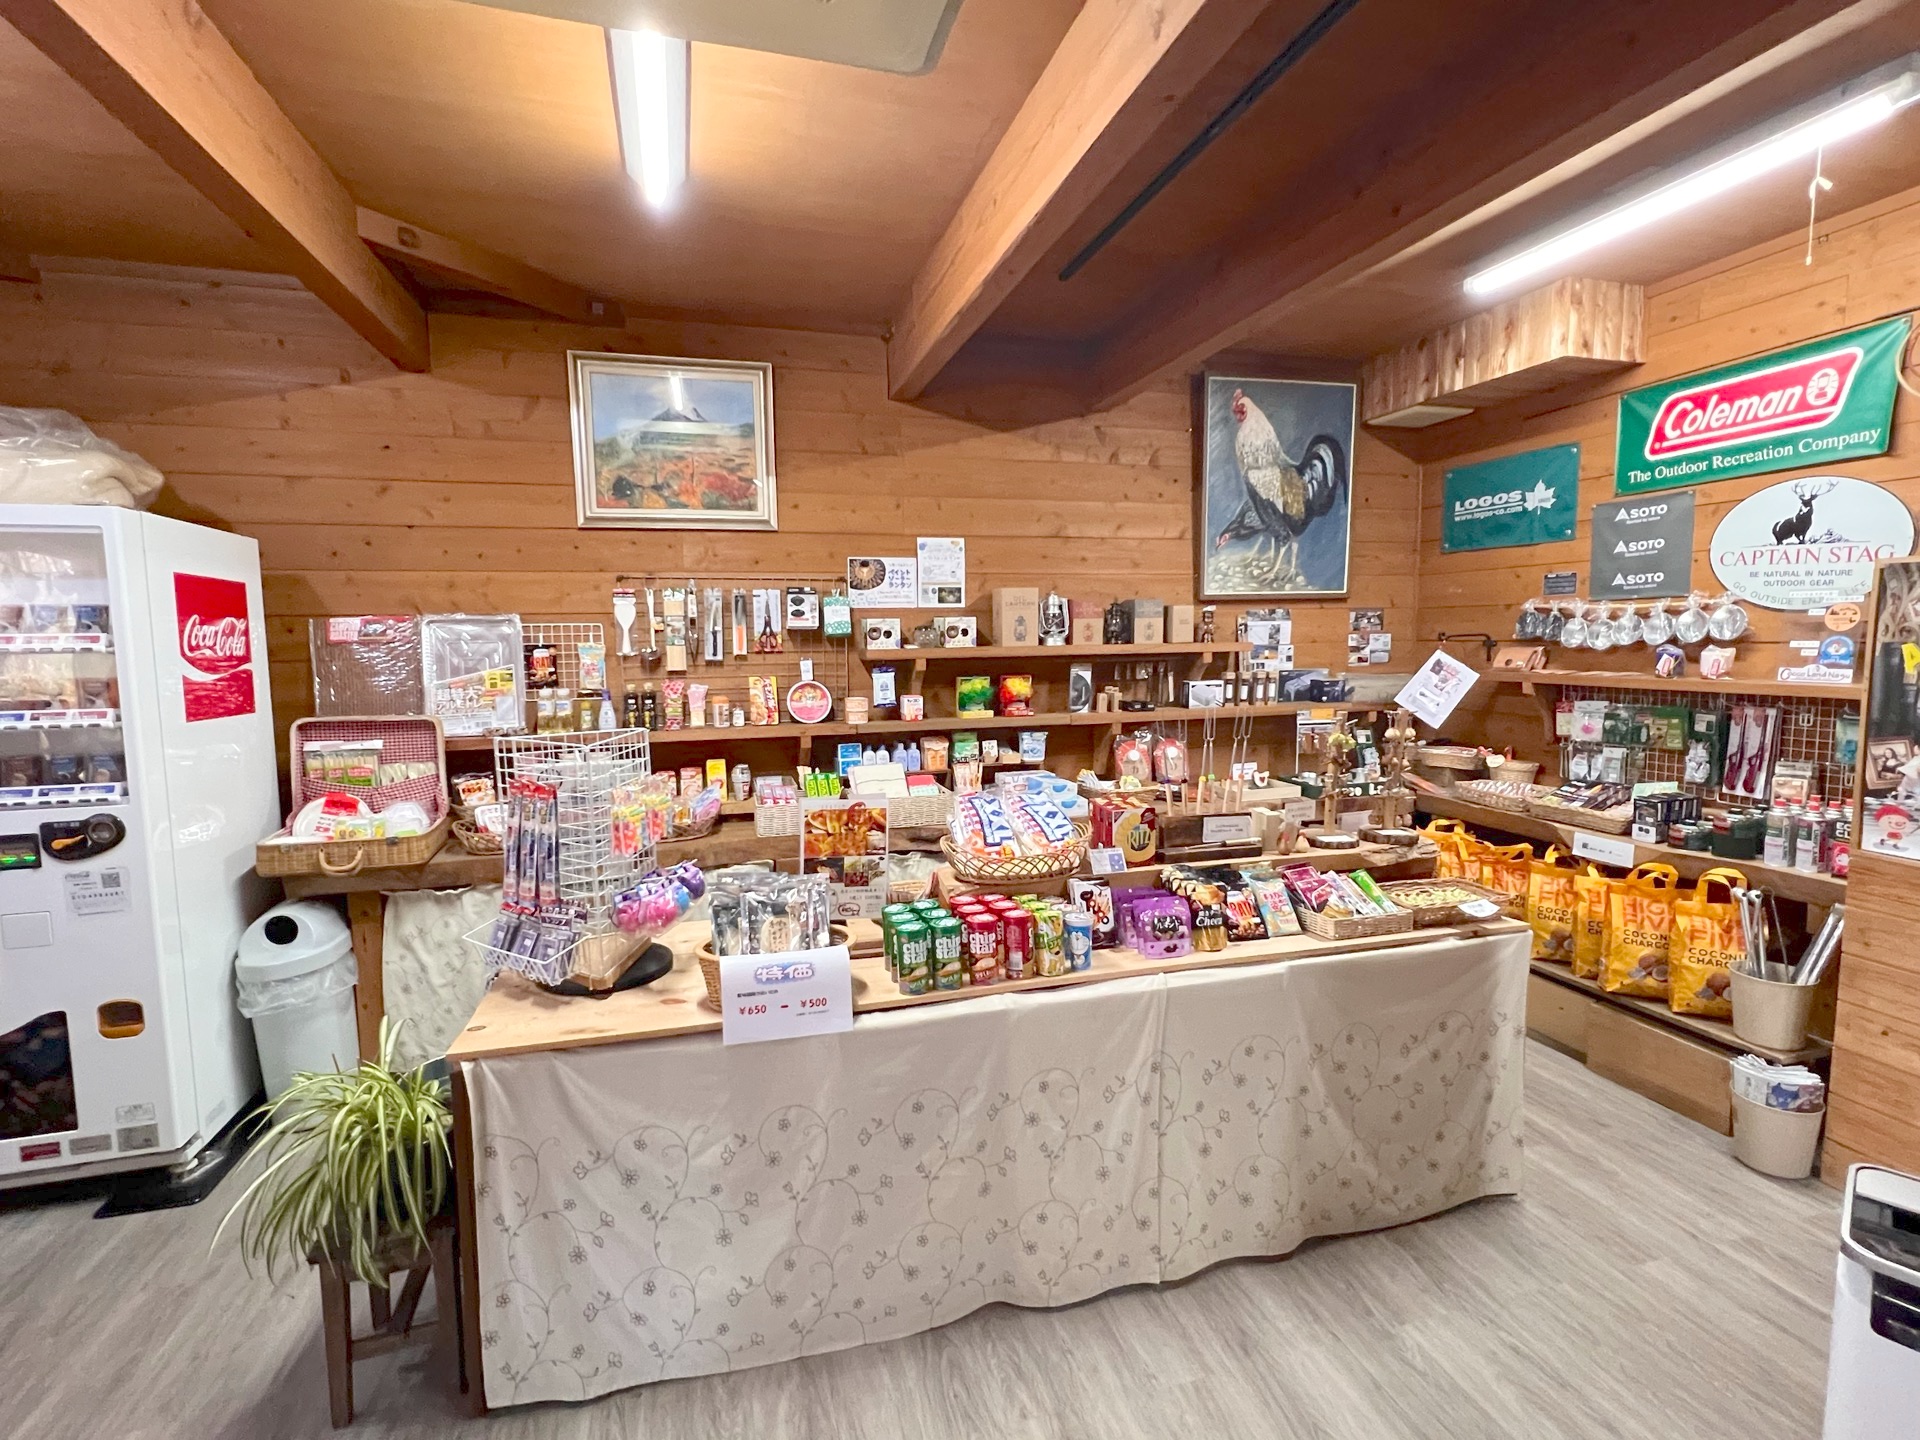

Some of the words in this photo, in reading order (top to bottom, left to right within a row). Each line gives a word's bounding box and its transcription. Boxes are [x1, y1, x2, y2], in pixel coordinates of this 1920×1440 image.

[1664, 385, 1803, 439] Coleman
[1627, 469, 1651, 484] The
[1654, 458, 1708, 479] Outdoor
[1712, 443, 1794, 469] Recreation
[1798, 427, 1882, 453] Company
[1454, 490, 1523, 512] LOGOS
[1630, 504, 1668, 519] SOTO
[1628, 538, 1666, 552] SOTO
[1719, 546, 1821, 567] CAPTAIN
[1828, 543, 1896, 563] STAG
[1626, 572, 1665, 585] SOTO
[1817, 569, 1853, 577] NATURE
[1763, 579, 1806, 587] OUTDOOR
[1732, 581, 1747, 594] GO
[1750, 590, 1794, 606] OUTSIDE
[183, 614, 247, 657] Coca-Cola
[1129, 829, 1151, 849] RITZ
[1537, 905, 1573, 917] COCO
[969, 932, 996, 946] chip
[1623, 929, 1670, 941] COCON
[969, 942, 997, 955] star
[756, 962, 813, 983] 特価
